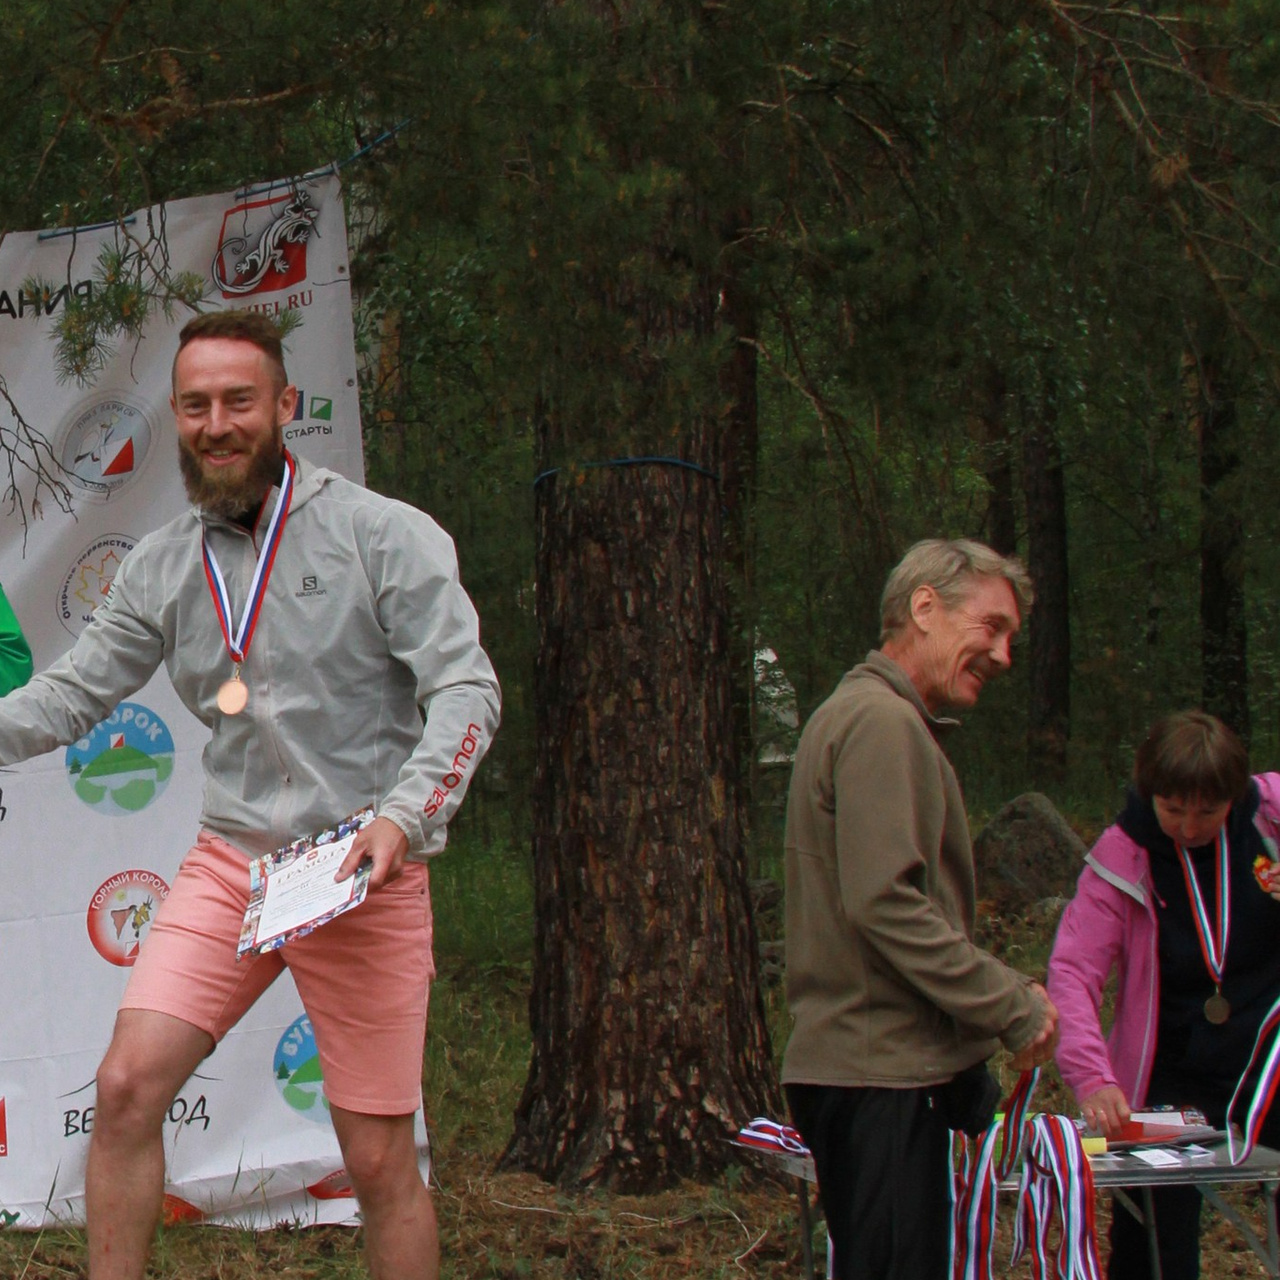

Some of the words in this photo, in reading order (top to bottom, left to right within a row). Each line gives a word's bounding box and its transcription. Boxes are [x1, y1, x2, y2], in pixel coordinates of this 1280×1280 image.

[285, 425, 333, 441] СТАРТЫ
[91, 871, 130, 911] ГОРНЫЙ
[132, 871, 170, 900] КОРОЛЬ
